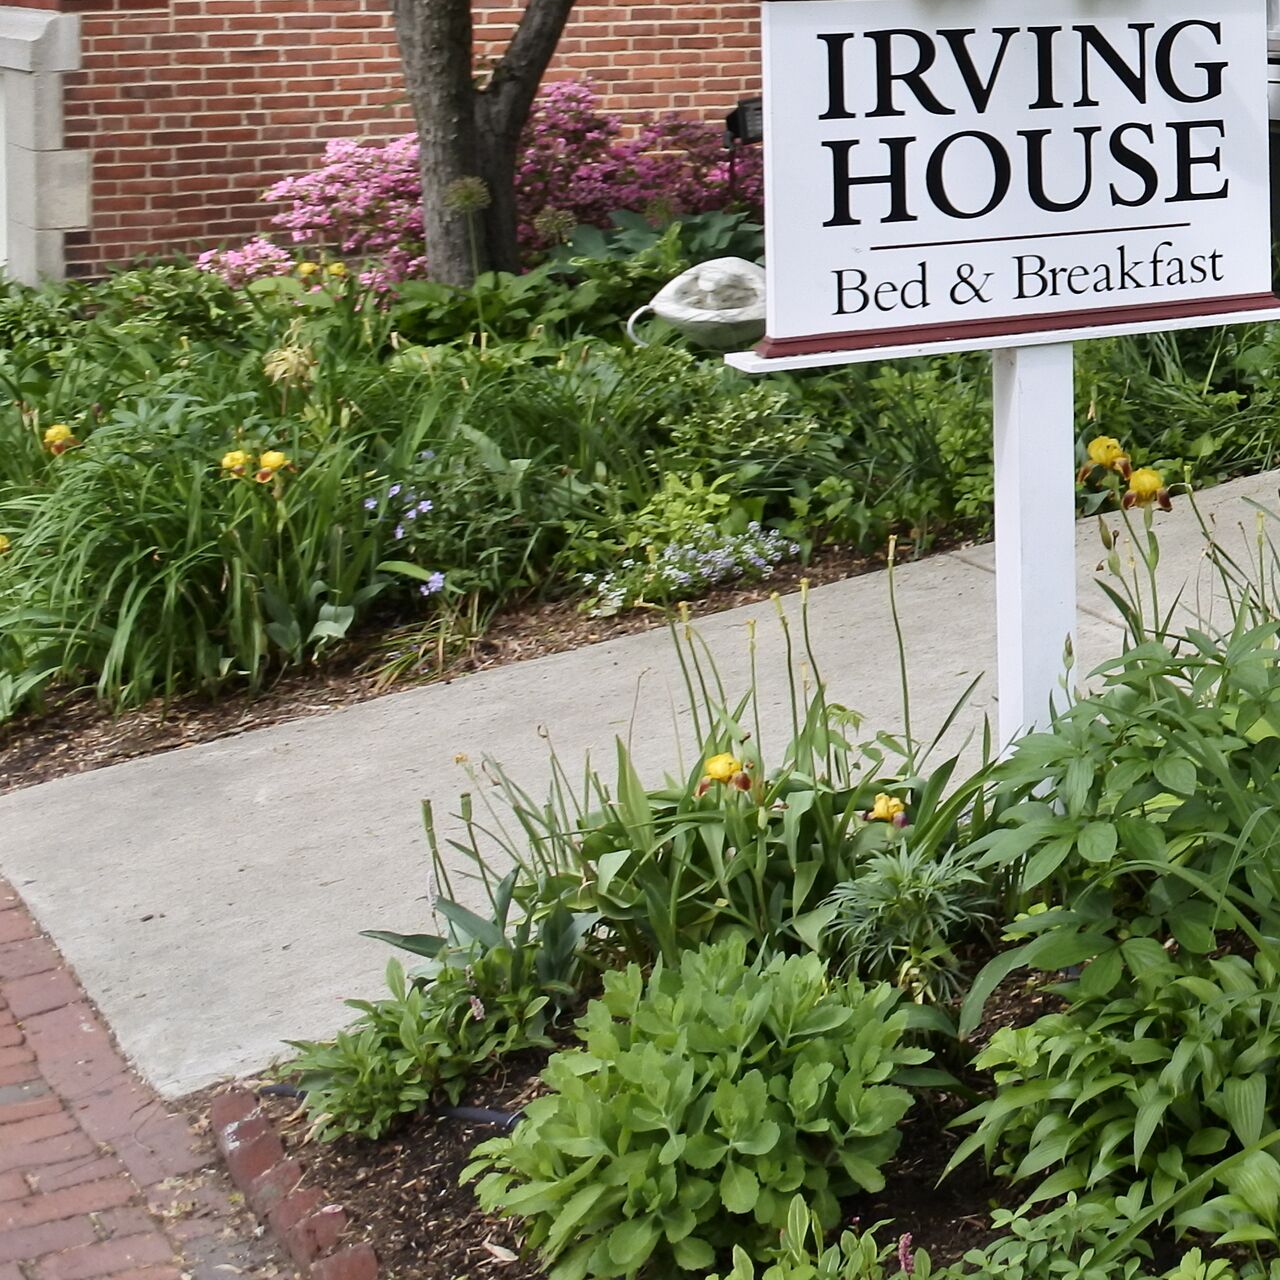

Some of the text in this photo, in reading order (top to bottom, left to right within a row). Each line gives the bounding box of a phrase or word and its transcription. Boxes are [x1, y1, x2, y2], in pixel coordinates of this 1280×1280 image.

[816, 20, 1228, 120] IRVING
[821, 120, 1229, 227] HOUSE
[831, 241, 1224, 315] Bed & Breakfast
